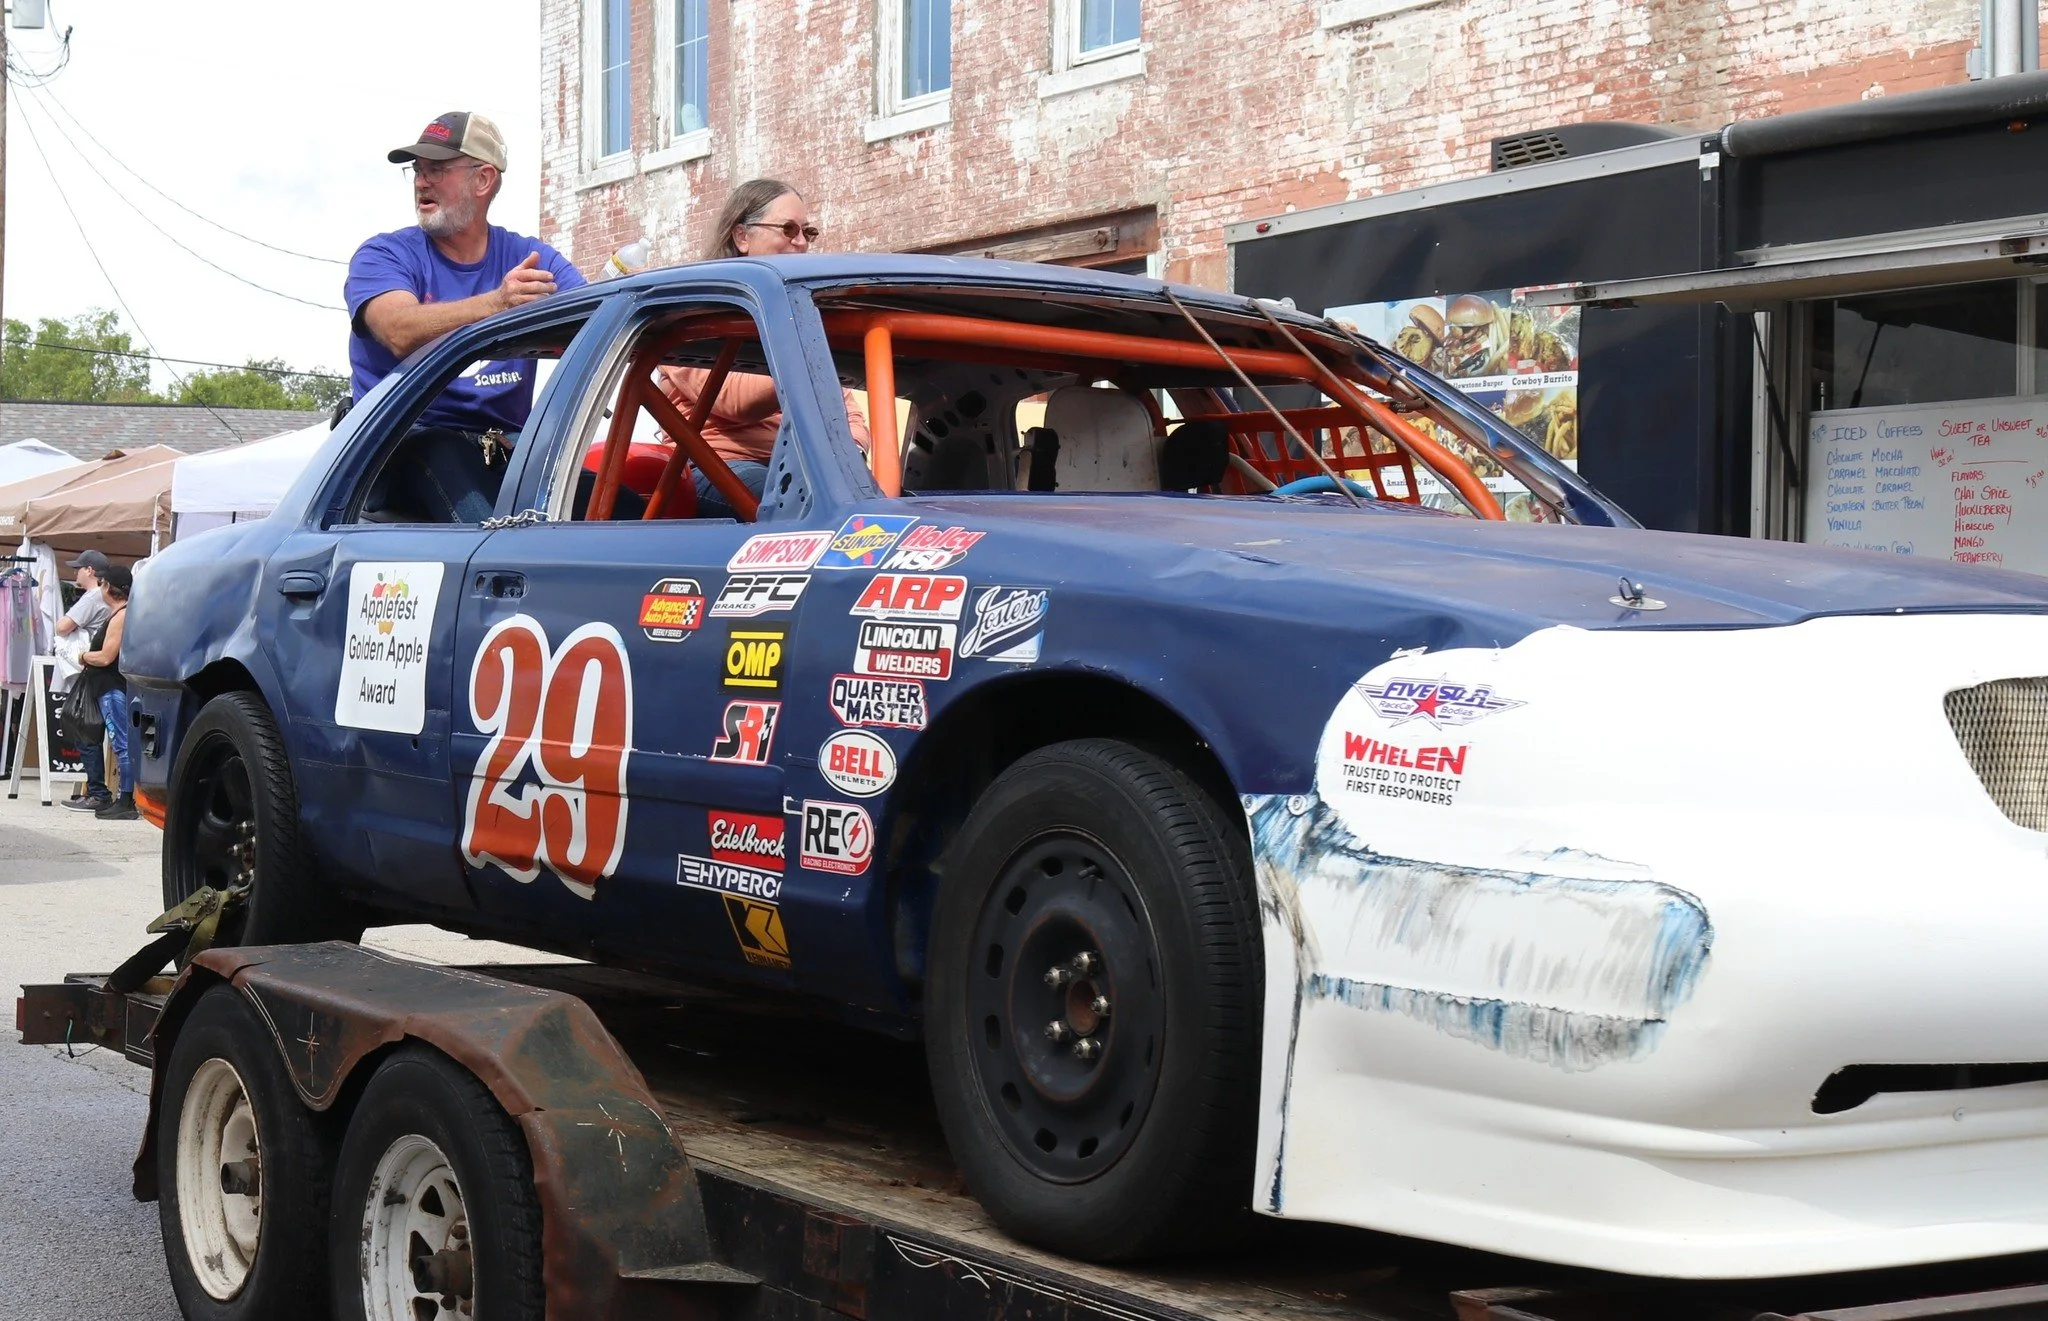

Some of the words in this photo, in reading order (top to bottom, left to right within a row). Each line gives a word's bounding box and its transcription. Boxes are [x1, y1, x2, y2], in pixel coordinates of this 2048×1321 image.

[1483, 380, 1503, 389] Burger
[1512, 377, 1541, 386] Cowboy
[1543, 374, 1573, 384] Burrito
[1830, 426, 1867, 441] ICED
[1938, 420, 1974, 437] SWEET
[1991, 418, 2033, 432] UNSWEET
[1967, 434, 1991, 447] TEA
[1871, 448, 1903, 462] MOCHA
[1424, 478, 1435, 486] Boy
[1828, 467, 1867, 480] CARAMEL
[1827, 484, 1865, 497] CHOCOLATE
[1875, 482, 1913, 494] CARAMEL
[1827, 500, 1866, 513] SOUTHERN
[1872, 500, 1899, 511] BUTTER
[1901, 496, 1926, 510] PECAN
[1955, 502, 2012, 525] HUCKLEBERRY
[1827, 518, 1862, 531] VANILLA
[737, 537, 825, 564] SIMPSON
[836, 533, 896, 550] SUNOCO
[898, 525, 987, 555] Holley
[1954, 536, 1984, 550] MANGO
[881, 550, 954, 571] MSD
[719, 577, 807, 601] PFC
[856, 576, 965, 611] ARP
[360, 593, 419, 627] Applefest
[650, 598, 686, 613] Advance
[643, 611, 661, 623] Auto
[662, 612, 682, 625] Parts
[959, 586, 1049, 658] Jostens
[863, 626, 938, 651] LINCOLN
[349, 633, 383, 663] Golden
[386, 637, 423, 669] Apple
[726, 641, 781, 677] OMP
[875, 653, 942, 675] WELDERS
[359, 676, 397, 706] Award
[832, 679, 921, 707] QUARTER
[1383, 682, 1433, 699] FIVE
[846, 700, 923, 725] MASTER
[1440, 705, 1474, 717] Bodies
[461, 613, 633, 900] 29
[829, 743, 885, 778] BELL
[1344, 730, 1469, 775] WHELEN
[834, 773, 878, 787] HELMETS
[1343, 764, 1390, 781] TRUSTED
[1394, 770, 1407, 784] TO
[1410, 773, 1461, 792] PROTECT
[1346, 779, 1376, 795] FIRST
[1378, 783, 1453, 806] RESPONDERS
[711, 819, 786, 859] Edelbrock
[803, 857, 822, 868] RACING
[822, 859, 856, 872] ELECTRONICS
